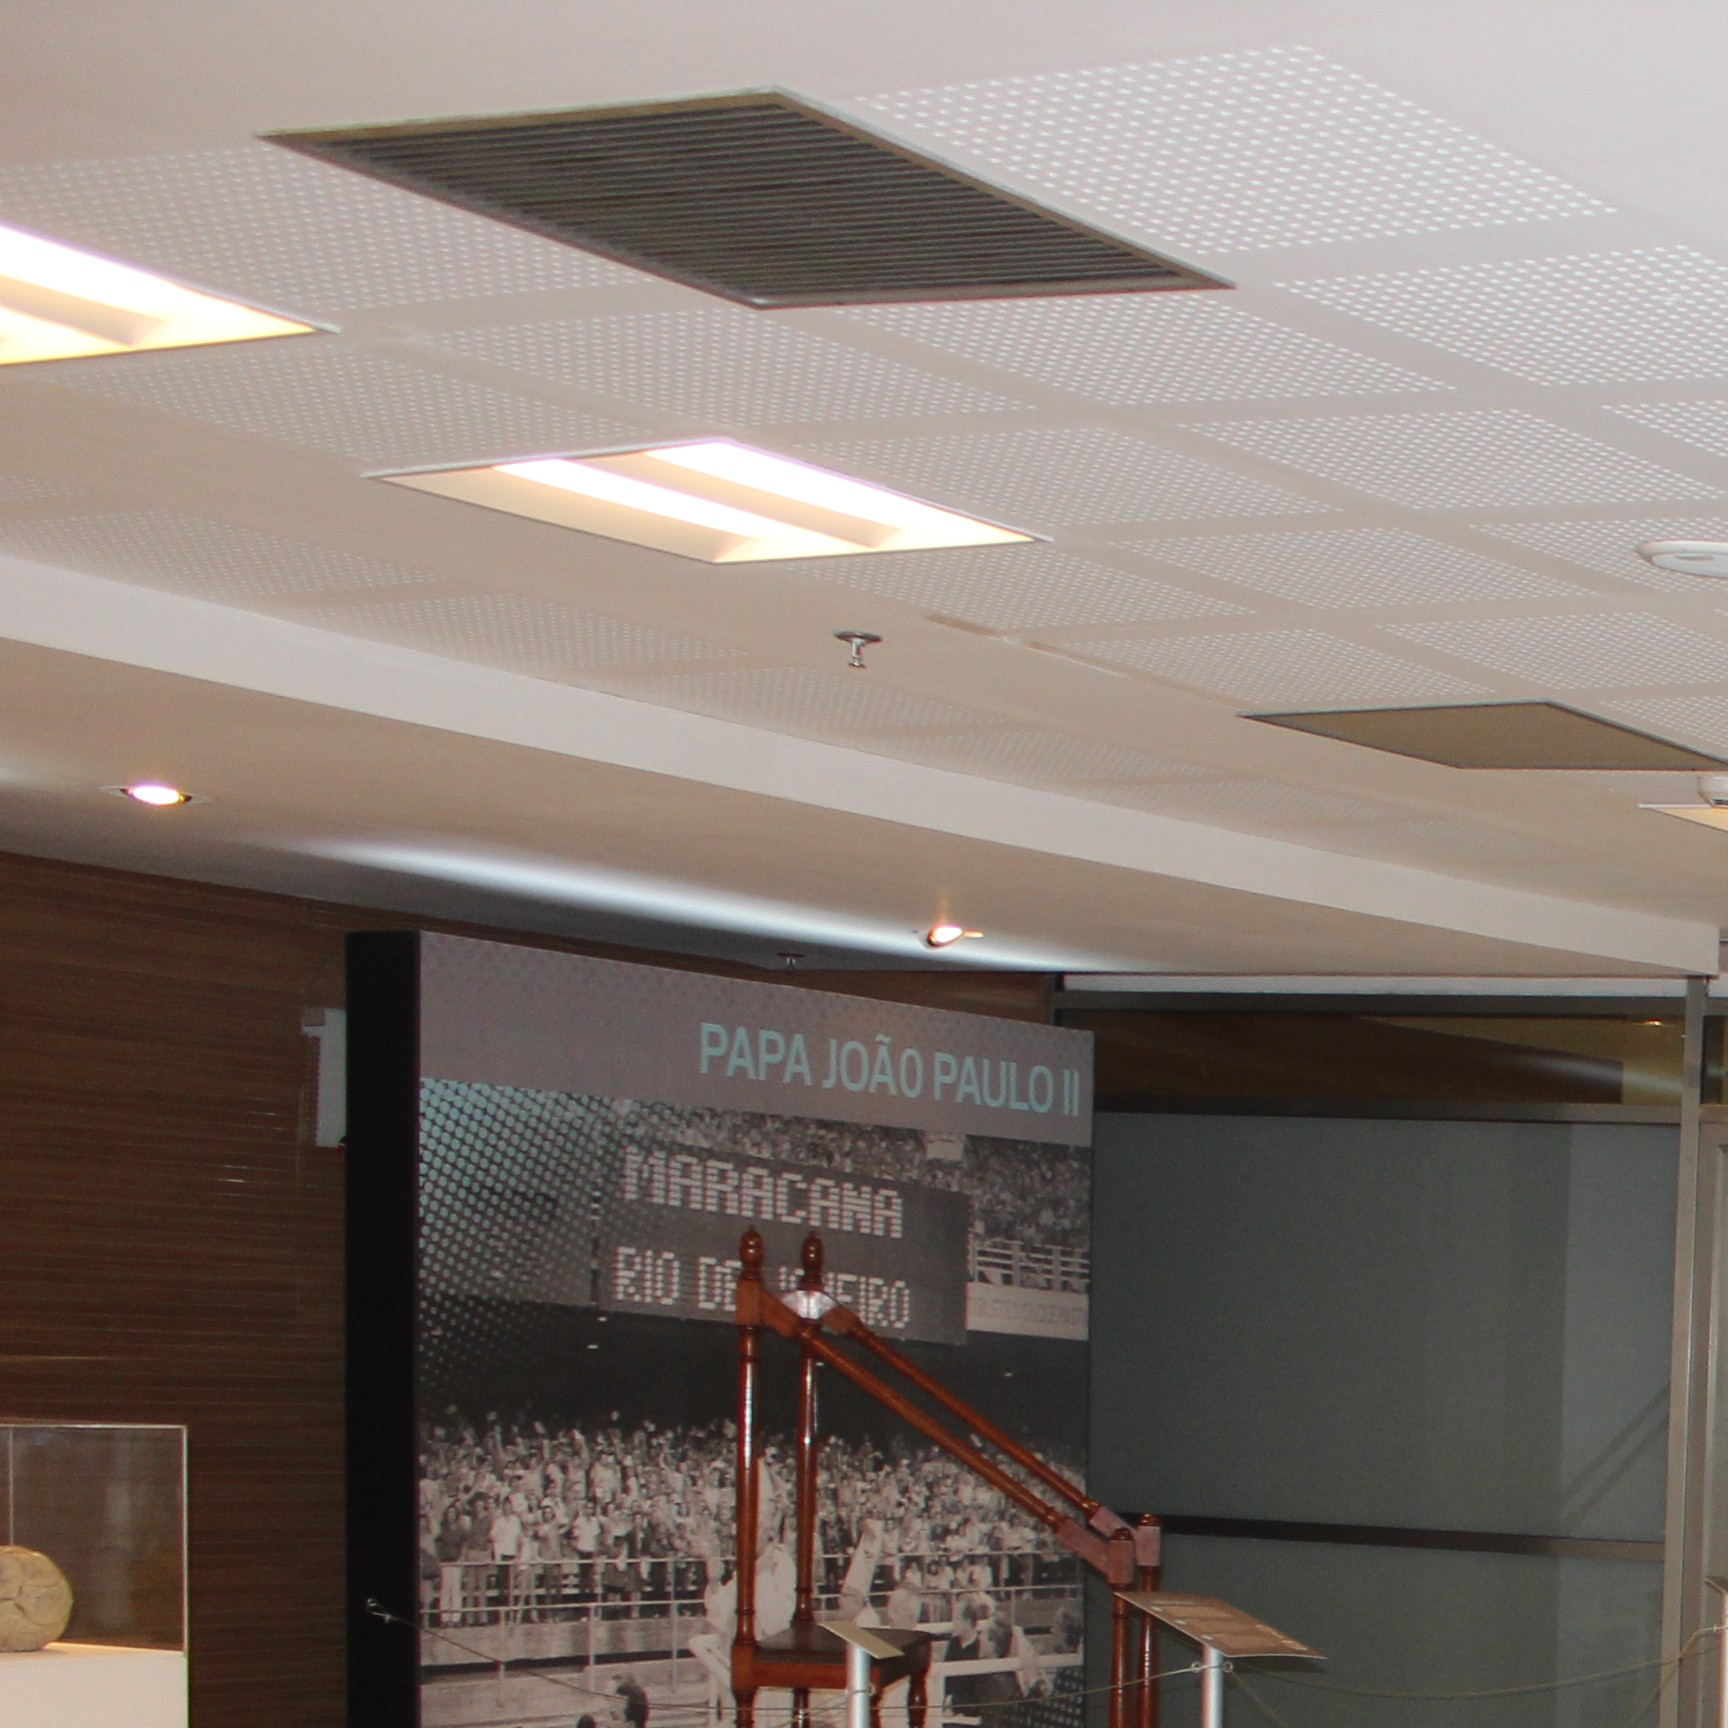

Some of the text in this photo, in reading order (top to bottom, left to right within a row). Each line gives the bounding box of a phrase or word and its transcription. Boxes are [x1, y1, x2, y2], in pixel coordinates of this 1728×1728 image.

[700, 1022, 1081, 1118] PAPA JOÃO PAULO II
[622, 1143, 905, 1240] MARACANA
[613, 1245, 680, 1306] RIO
[697, 1256, 743, 1312] DE
